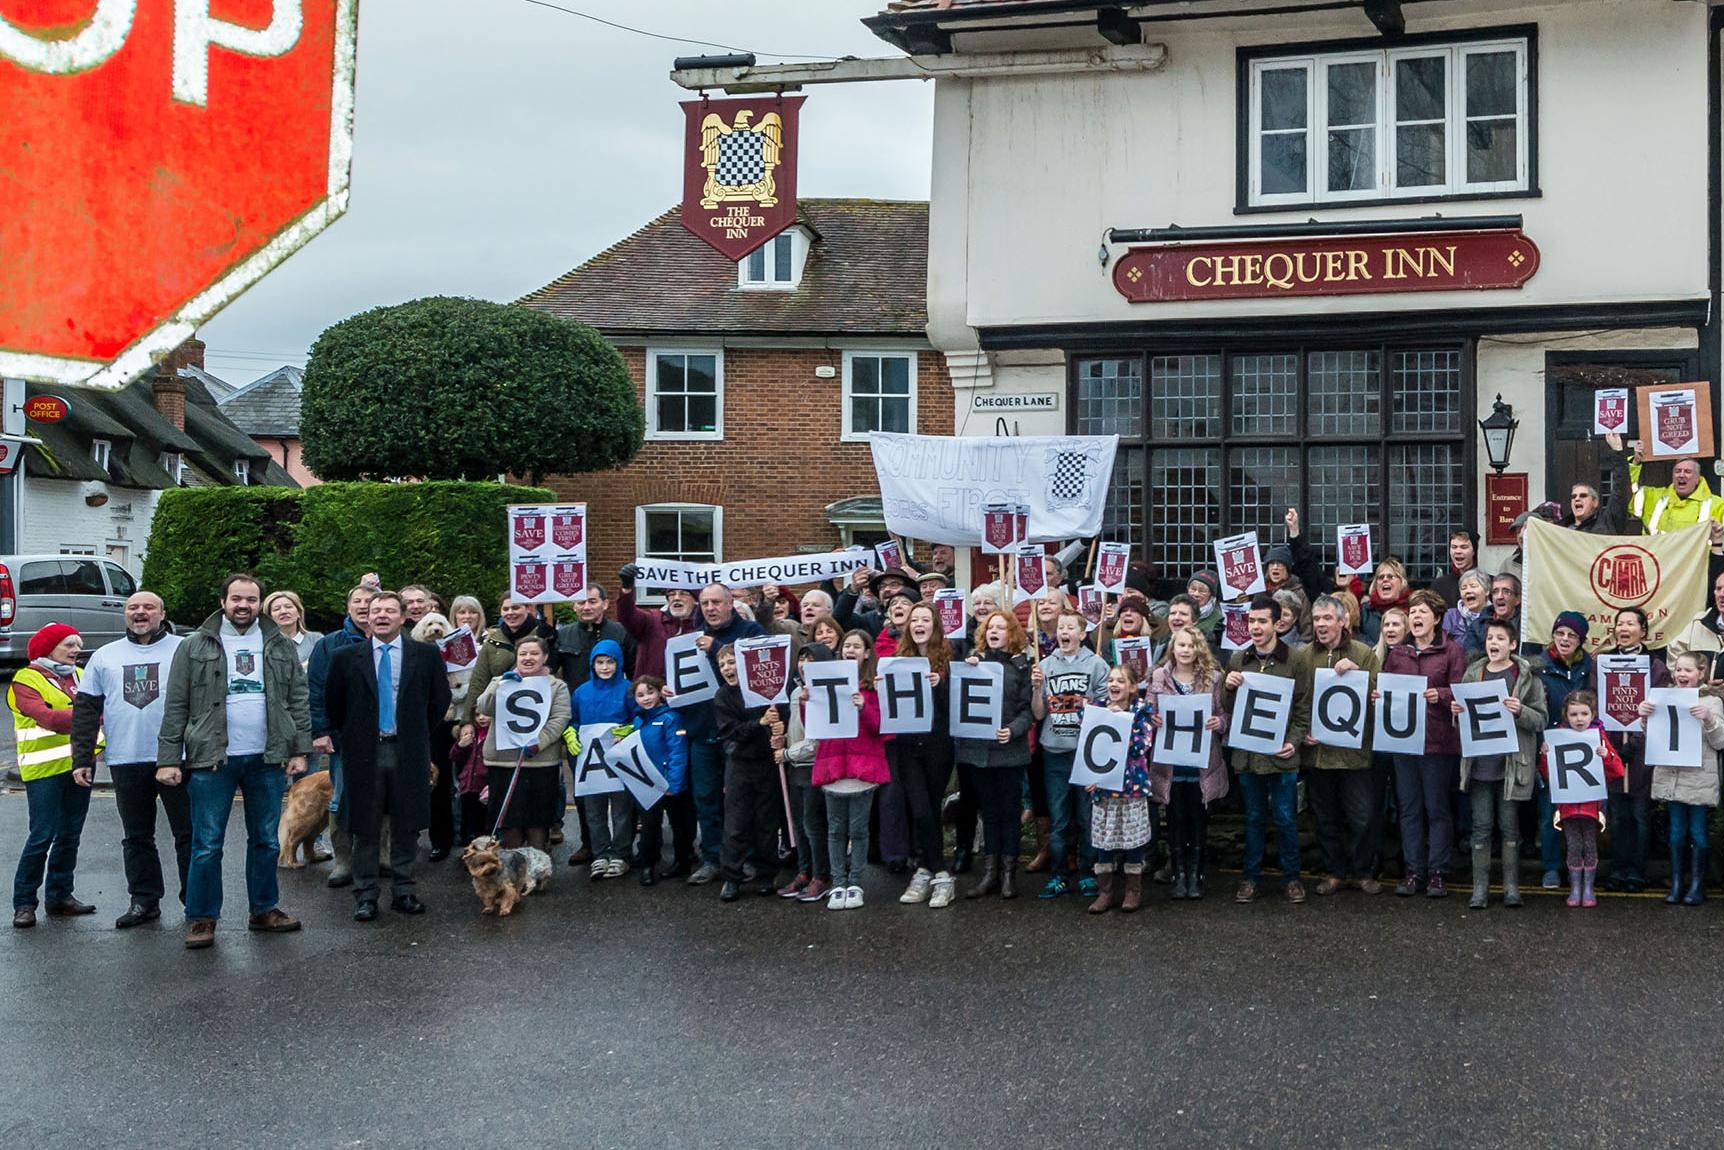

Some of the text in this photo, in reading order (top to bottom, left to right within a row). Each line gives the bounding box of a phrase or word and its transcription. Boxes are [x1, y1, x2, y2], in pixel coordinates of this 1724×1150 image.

[726, 206, 750, 217] THE
[710, 216, 765, 228] CHEQUER
[726, 228, 749, 239] INN
[1186, 246, 1457, 289] CHEQUER INN
[33, 402, 57, 411] POST
[974, 396, 1053, 407] CHEQUER LANE
[29, 410, 61, 419] OFFICE
[1600, 409, 1624, 418] SAVE
[1663, 416, 1686, 425] GRUB
[515, 529, 544, 538] SAVE
[635, 566, 678, 583] SAVE
[684, 570, 721, 585] THE
[729, 562, 825, 582] CHEQUER
[830, 559, 869, 576] INN
[1100, 566, 1122, 577] SAVE
[1226, 563, 1257, 578] SAVE
[1598, 557, 1648, 597] CAMRA
[752, 661, 780, 671] PINTS
[757, 669, 778, 678] NOT
[124, 679, 158, 694] SAVE
[1050, 676, 1089, 695] VANS
[1612, 687, 1638, 695] PINTS
[1615, 695, 1635, 703] NOT
[1607, 703, 1640, 711] POUND
